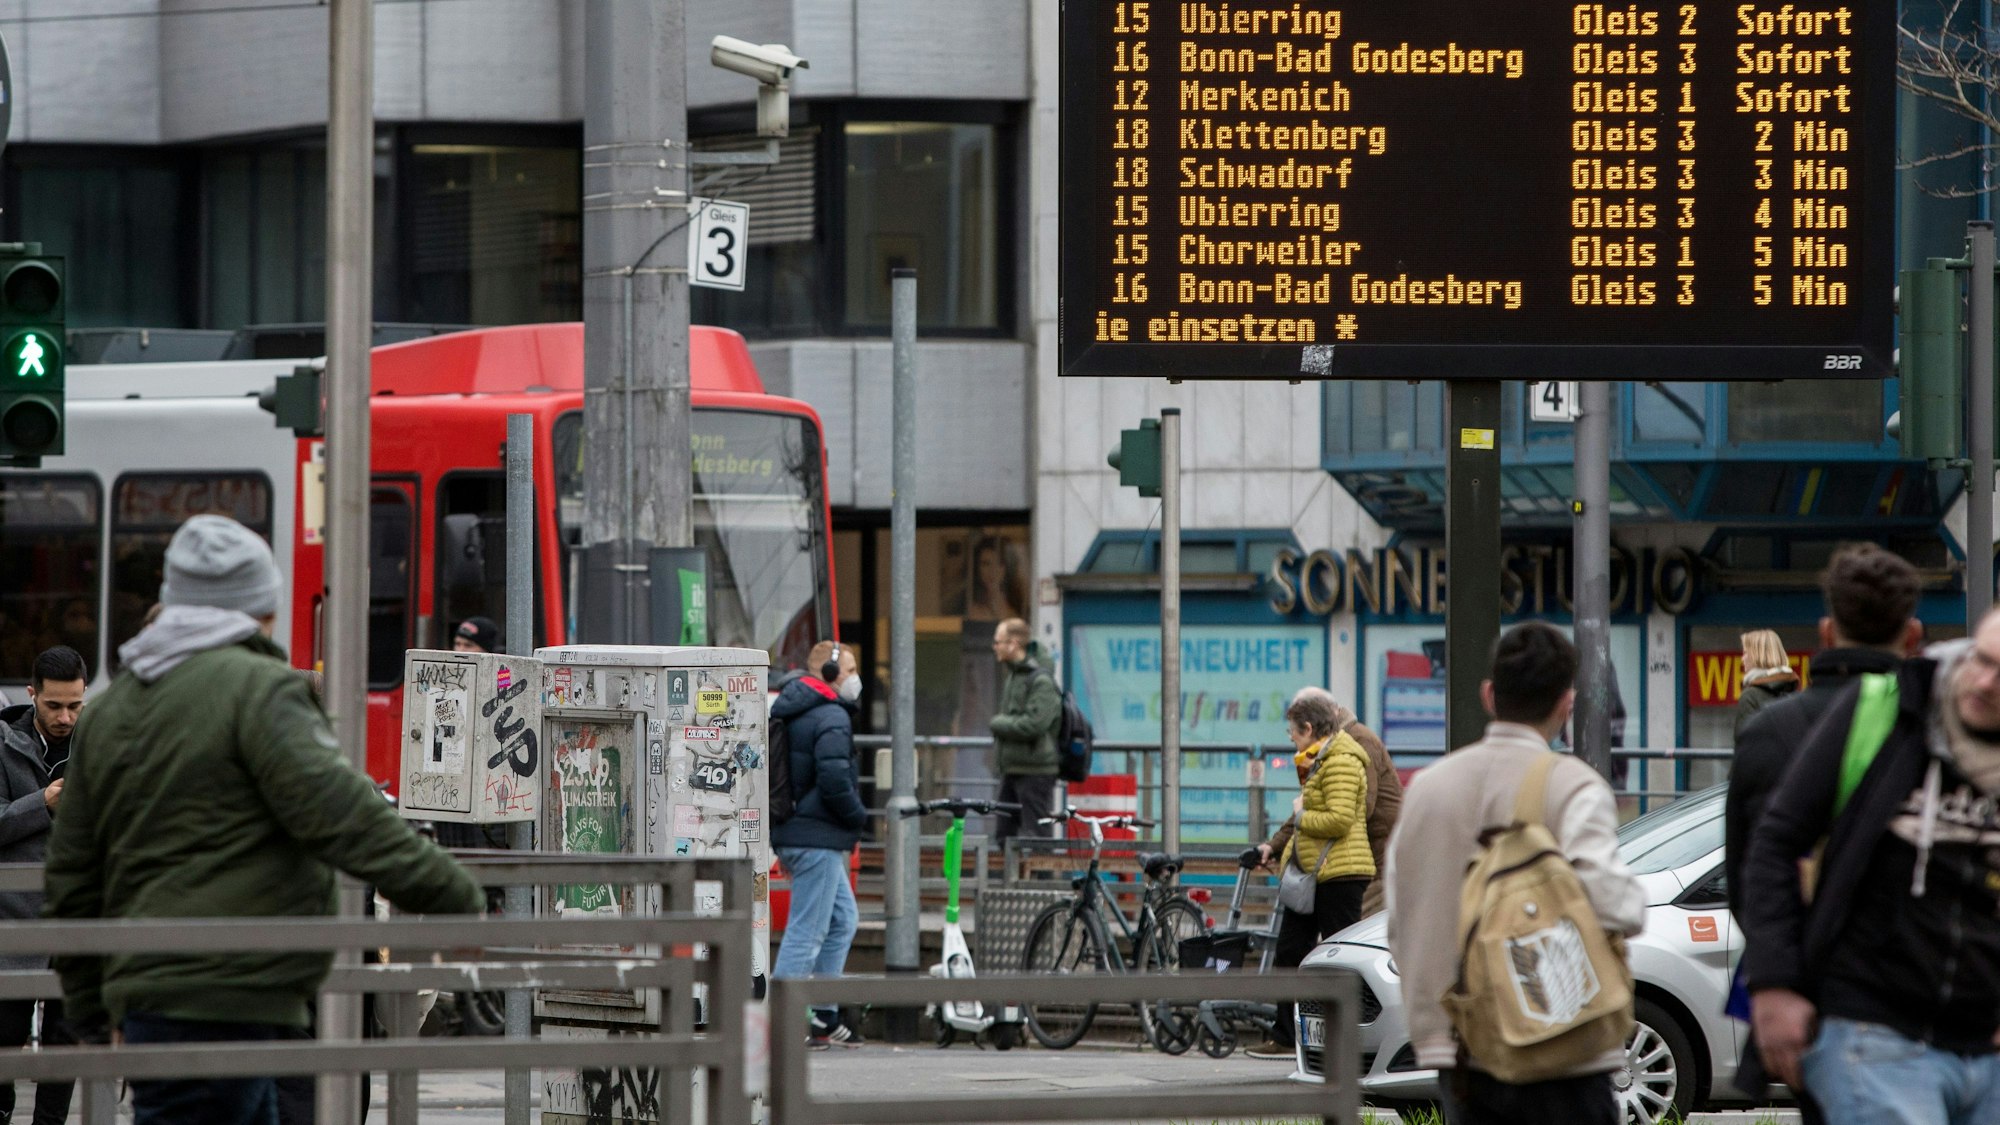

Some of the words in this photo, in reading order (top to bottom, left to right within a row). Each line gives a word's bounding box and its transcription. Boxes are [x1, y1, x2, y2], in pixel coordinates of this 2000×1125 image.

[1113, 2, 1149, 34] 15
[1180, 2, 1341, 40] Ubierring
[1573, 4, 1659, 36] Gleis
[1679, 4, 1697, 36] 2
[1736, 4, 1852, 36] Sofort
[1113, 41, 1149, 72] 16
[1180, 41, 1332, 73] Bonn-Bad
[1352, 42, 1523, 79] Godesberg
[1572, 42, 1658, 74] Gleis
[1678, 42, 1697, 74] 3
[1736, 42, 1852, 74] Sofort
[1113, 79, 1149, 111] 12
[1180, 79, 1350, 112] Merkenich
[1572, 81, 1658, 113] Gleis
[1678, 81, 1696, 113] 1
[1736, 81, 1851, 113] Sofort
[1113, 118, 1149, 149] 18
[1180, 118, 1386, 155] Klettenberg
[1572, 120, 1657, 152] Gleis
[1677, 120, 1696, 152] 3
[1755, 120, 1774, 152] 2
[1793, 120, 1848, 152] Min
[1113, 156, 1149, 188] 18
[1179, 157, 1352, 189] Schwadorf
[1571, 158, 1657, 190] Gleis
[1677, 158, 1696, 190] 3
[1754, 159, 1773, 190] 3
[1793, 159, 1848, 190] Min
[710, 208, 737, 222] Gleis
[1112, 195, 1149, 226] 15
[1179, 195, 1340, 232] Ubierring
[1571, 197, 1657, 229] Gleis
[1677, 197, 1696, 229] 3
[1754, 197, 1773, 229] 4
[1793, 197, 1848, 229] Min
[705, 227, 735, 277] 3
[1112, 233, 1148, 265] 15
[1179, 233, 1361, 266] Chorweiler
[1571, 235, 1657, 267] Gleis
[1677, 236, 1695, 267] 1
[1754, 236, 1773, 267] 5
[1792, 236, 1848, 267] Min
[1112, 272, 1148, 303] 16
[1179, 272, 1330, 304] Bonn-Bad
[1351, 273, 1522, 310] Godesberg
[1571, 274, 1656, 305] Gleis
[1677, 274, 1695, 306] 3
[1753, 274, 1772, 306] 5
[1792, 274, 1847, 306] Min
[1095, 310, 1129, 342] ie
[1148, 311, 1316, 342] einsetzen
[1824, 355, 1862, 370] BBR
[1543, 381, 1563, 411] 4
[691, 434, 725, 450] onn
[692, 453, 773, 477] desberg
[1269, 547, 1696, 616] SONNESTUDIO
[1108, 638, 1310, 673] WELNEUHEIT
[702, 693, 723, 701] 50999
[1149, 691, 1261, 729] Clifornia
[713, 719, 735, 728] SMASH
[564, 791, 617, 807] LIMASTREIK
[588, 817, 603, 837] FOR
[582, 884, 608, 909] FUTUR
